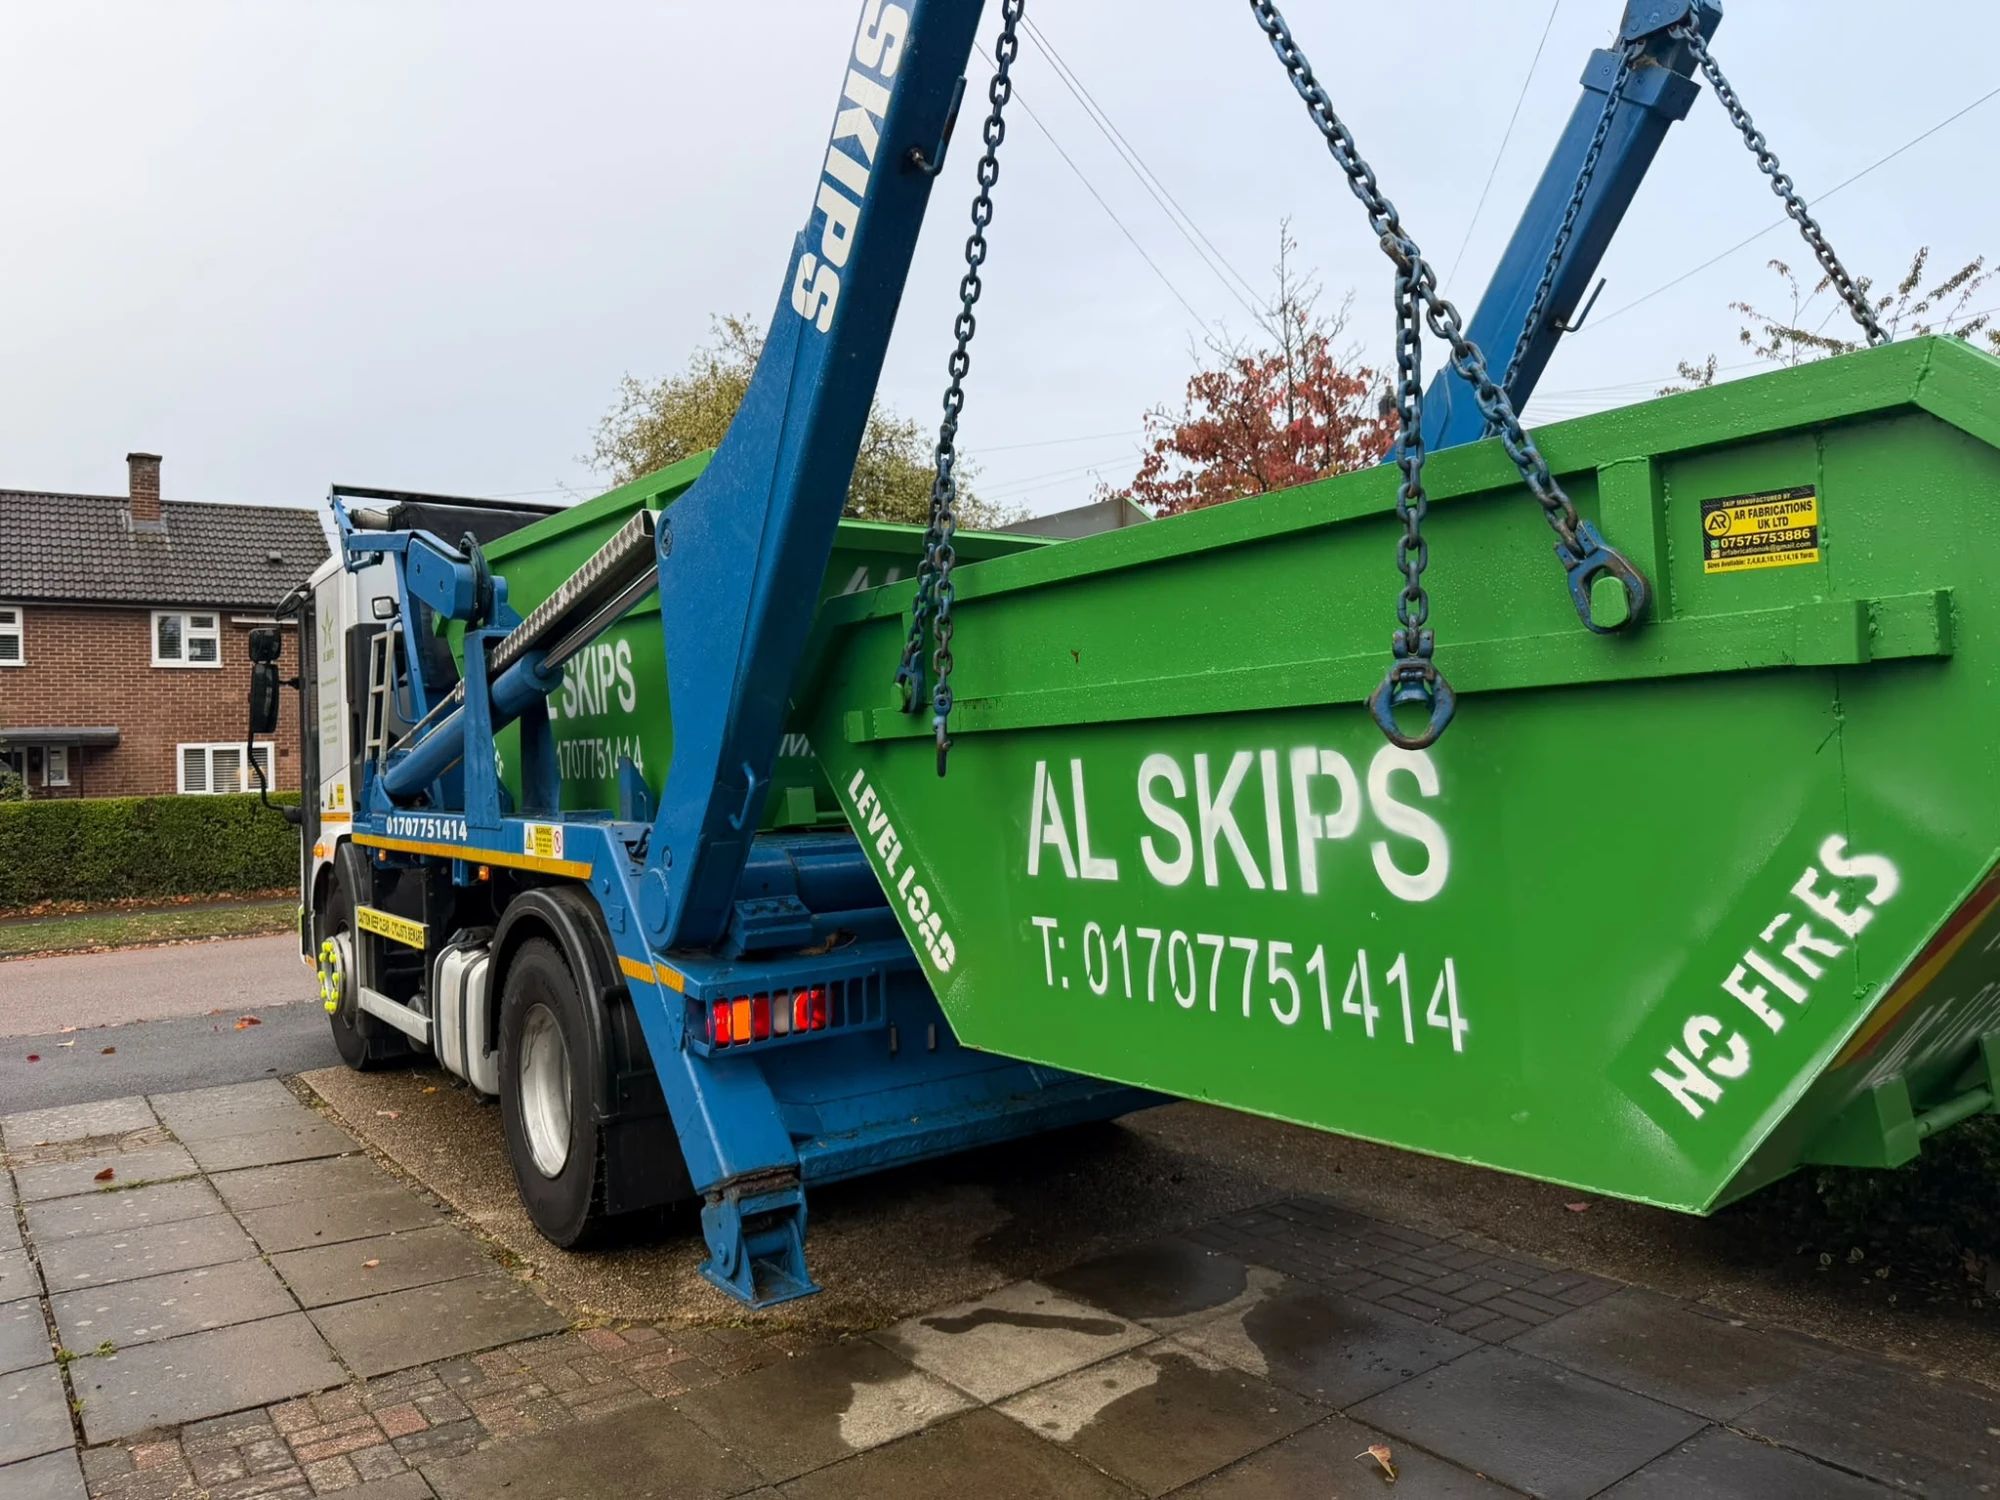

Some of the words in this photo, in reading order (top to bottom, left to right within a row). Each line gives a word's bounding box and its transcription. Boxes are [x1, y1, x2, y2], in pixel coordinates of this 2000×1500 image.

[791, 0, 909, 334] SKIPS
[1721, 528, 1811, 548] 07575753886
[1722, 500, 1735, 508] SKIP
[1734, 509, 1746, 520] AR
[1748, 501, 1813, 519] FABRICATIONS
[1757, 518, 1770, 529] UK
[1773, 516, 1789, 527] LTD
[562, 639, 636, 719] SKIPS
[386, 815, 468, 841] 01707751414
[1027, 758, 1118, 881] AL
[1137, 746, 1451, 902] SKIPS
[848, 768, 903, 878] LEVEL
[897, 865, 956, 974] LOAD
[1032, 915, 1069, 989] T:
[1083, 920, 1469, 1053] 01707751414
[1650, 1014, 1752, 1120] NO
[1721, 834, 1899, 1034] FIRES
